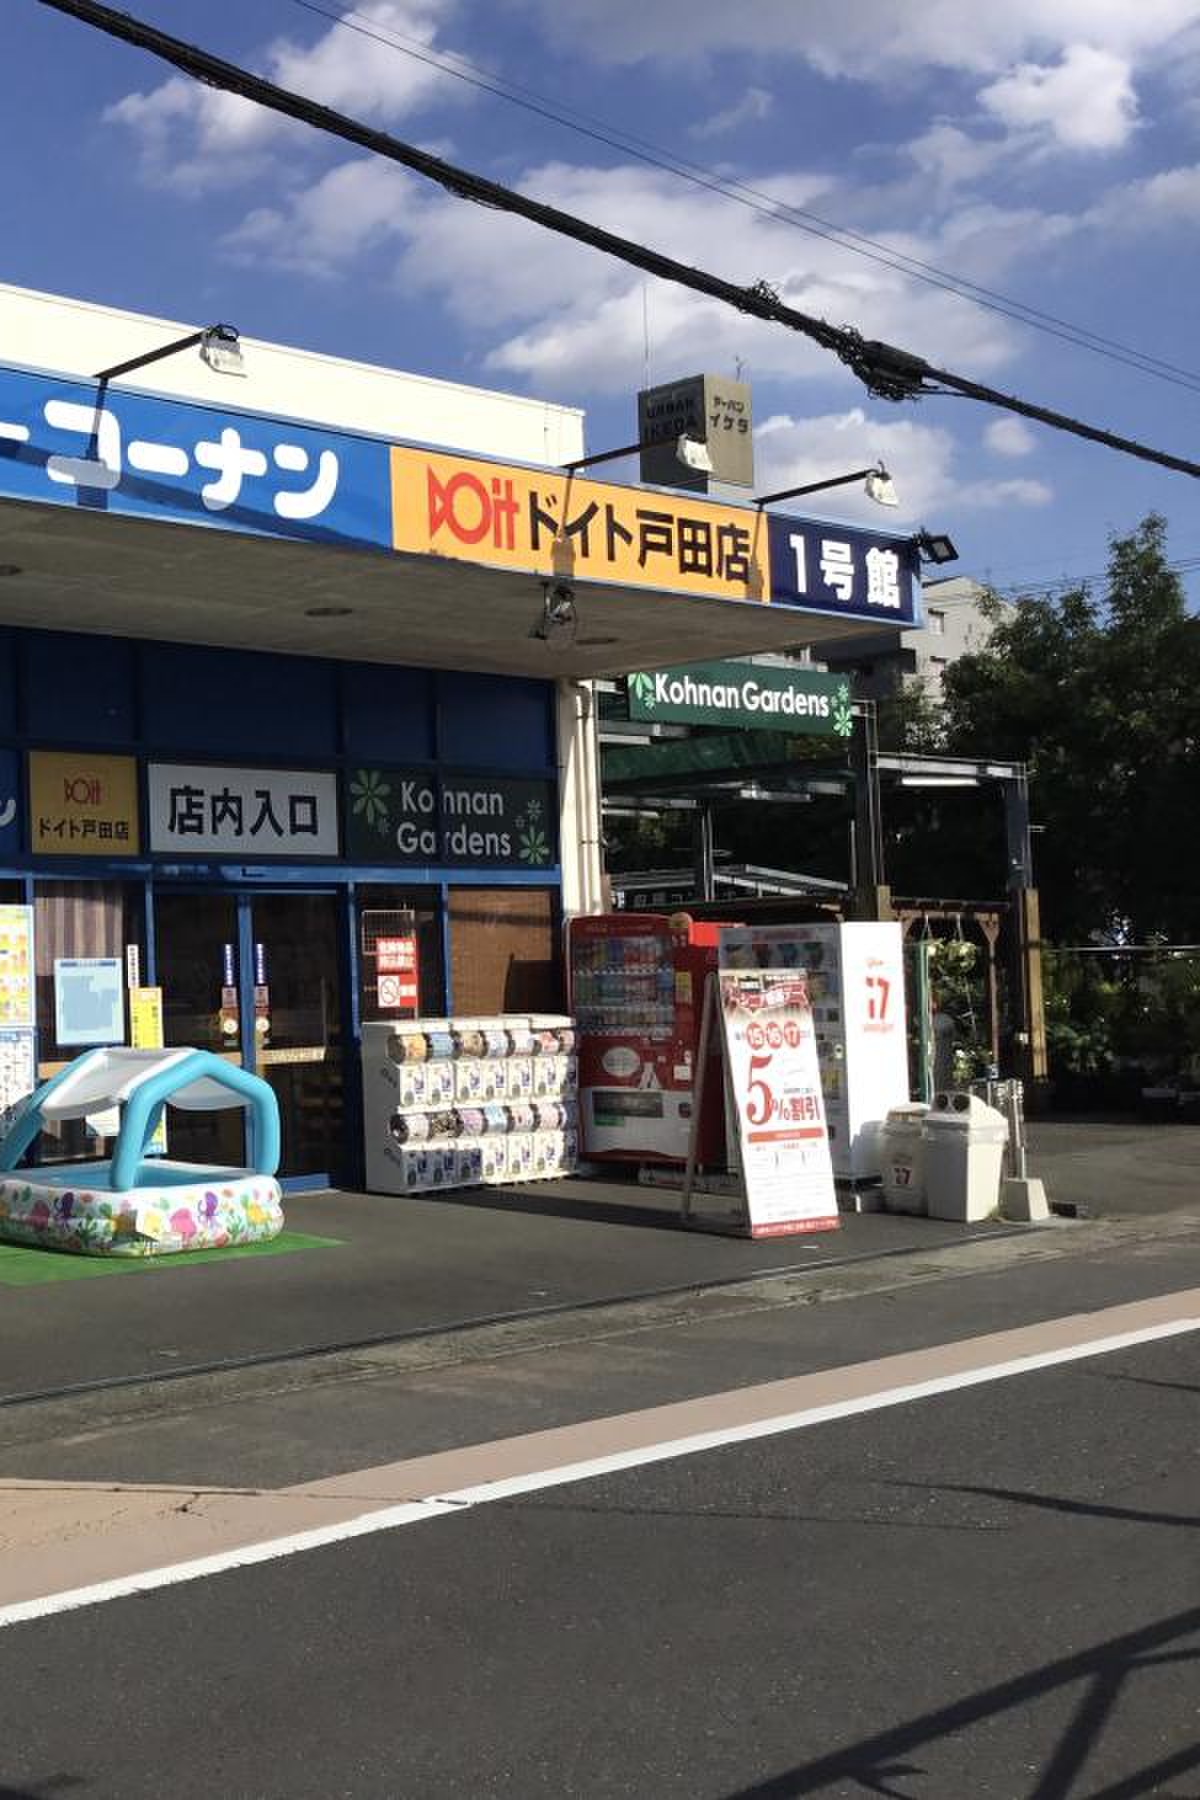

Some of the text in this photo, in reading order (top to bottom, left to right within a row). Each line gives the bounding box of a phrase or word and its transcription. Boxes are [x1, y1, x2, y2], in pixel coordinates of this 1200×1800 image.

[709, 414, 749, 433] イケダ
[40, 398, 339, 520] コーナン
[529, 489, 750, 584] ドイト戸田店
[789, 533, 901, 610] 1号館
[655, 673, 830, 718] Kohnan Gardens
[40, 817, 129, 840] ドイト戸田店
[168, 786, 320, 838] 店内入口
